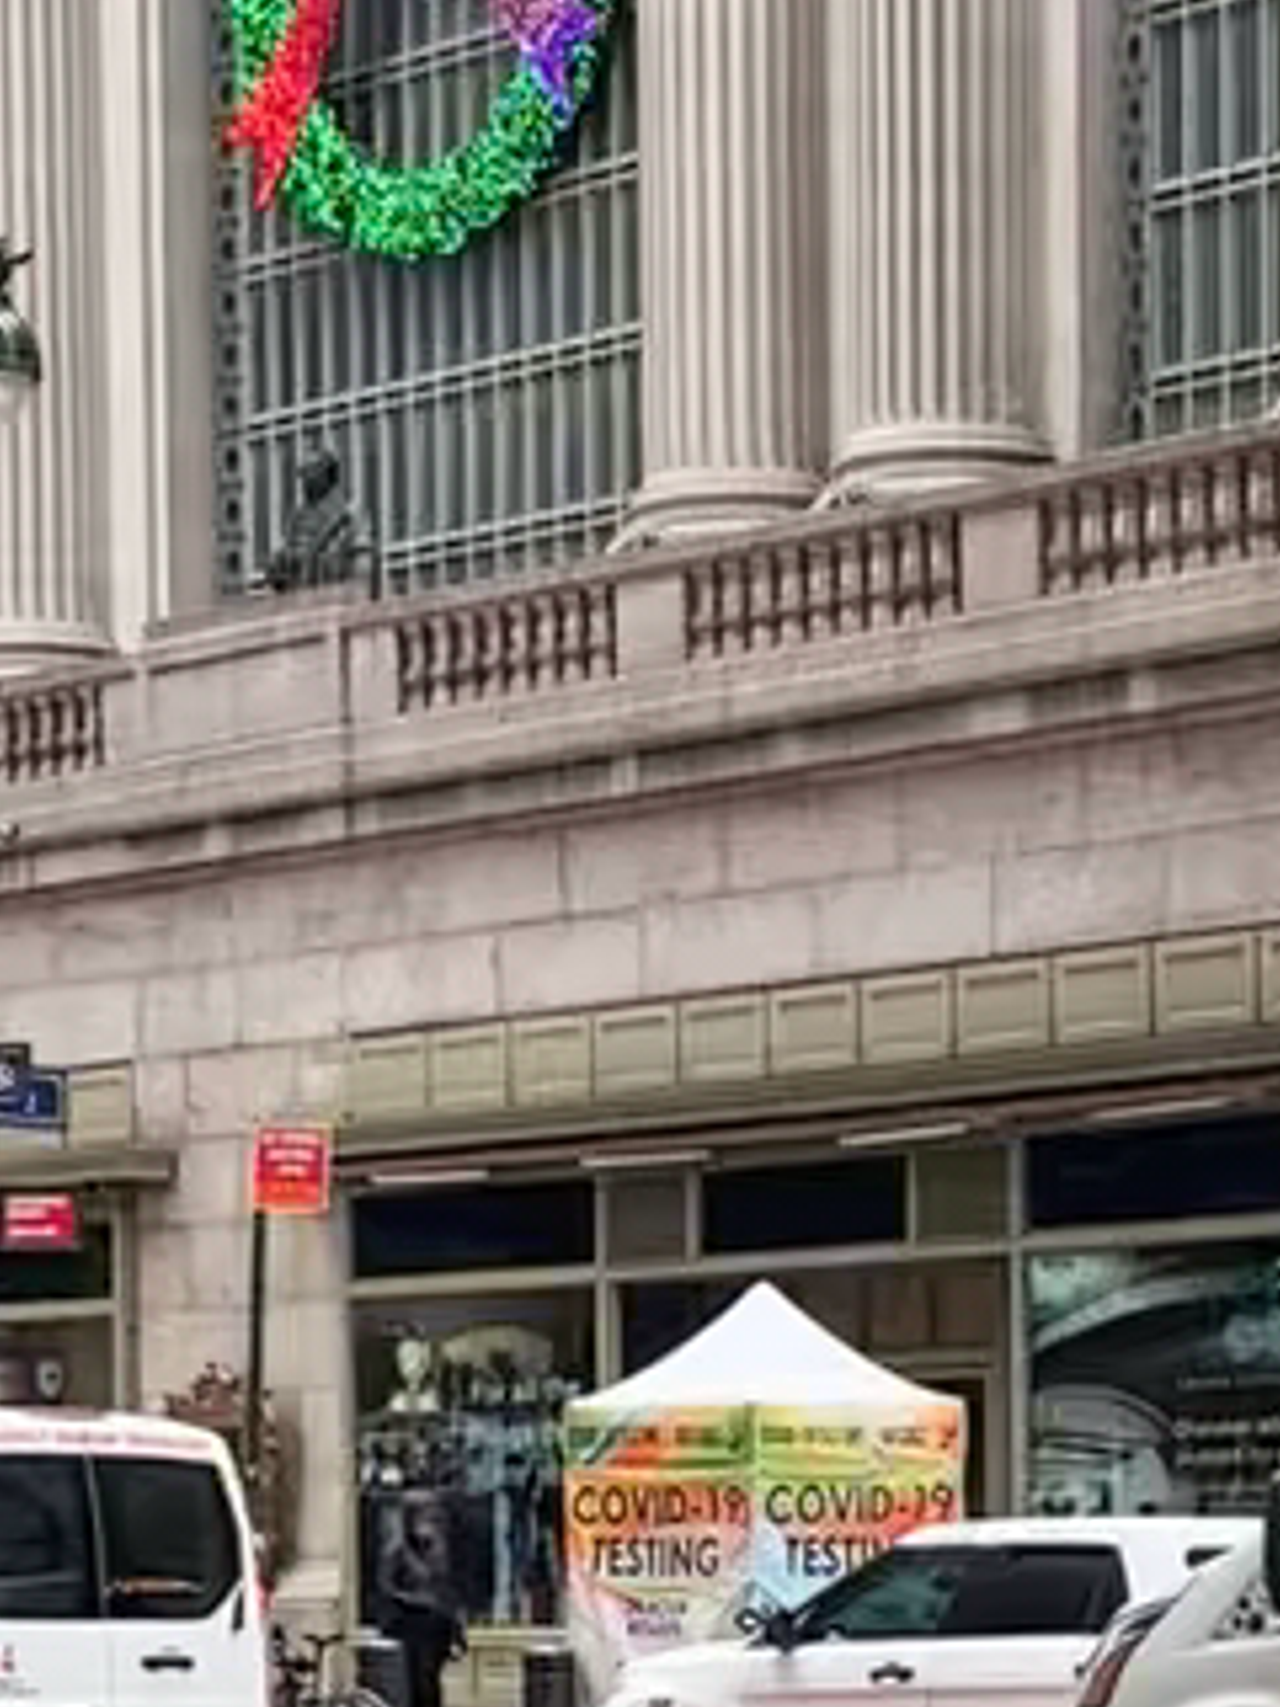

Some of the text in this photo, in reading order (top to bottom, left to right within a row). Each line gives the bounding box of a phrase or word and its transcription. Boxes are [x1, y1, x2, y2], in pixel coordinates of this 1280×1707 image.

[571, 1484, 748, 1526] COVID-19
[765, 1483, 953, 1524] COVID-19
[593, 1536, 719, 1578] TESTING
